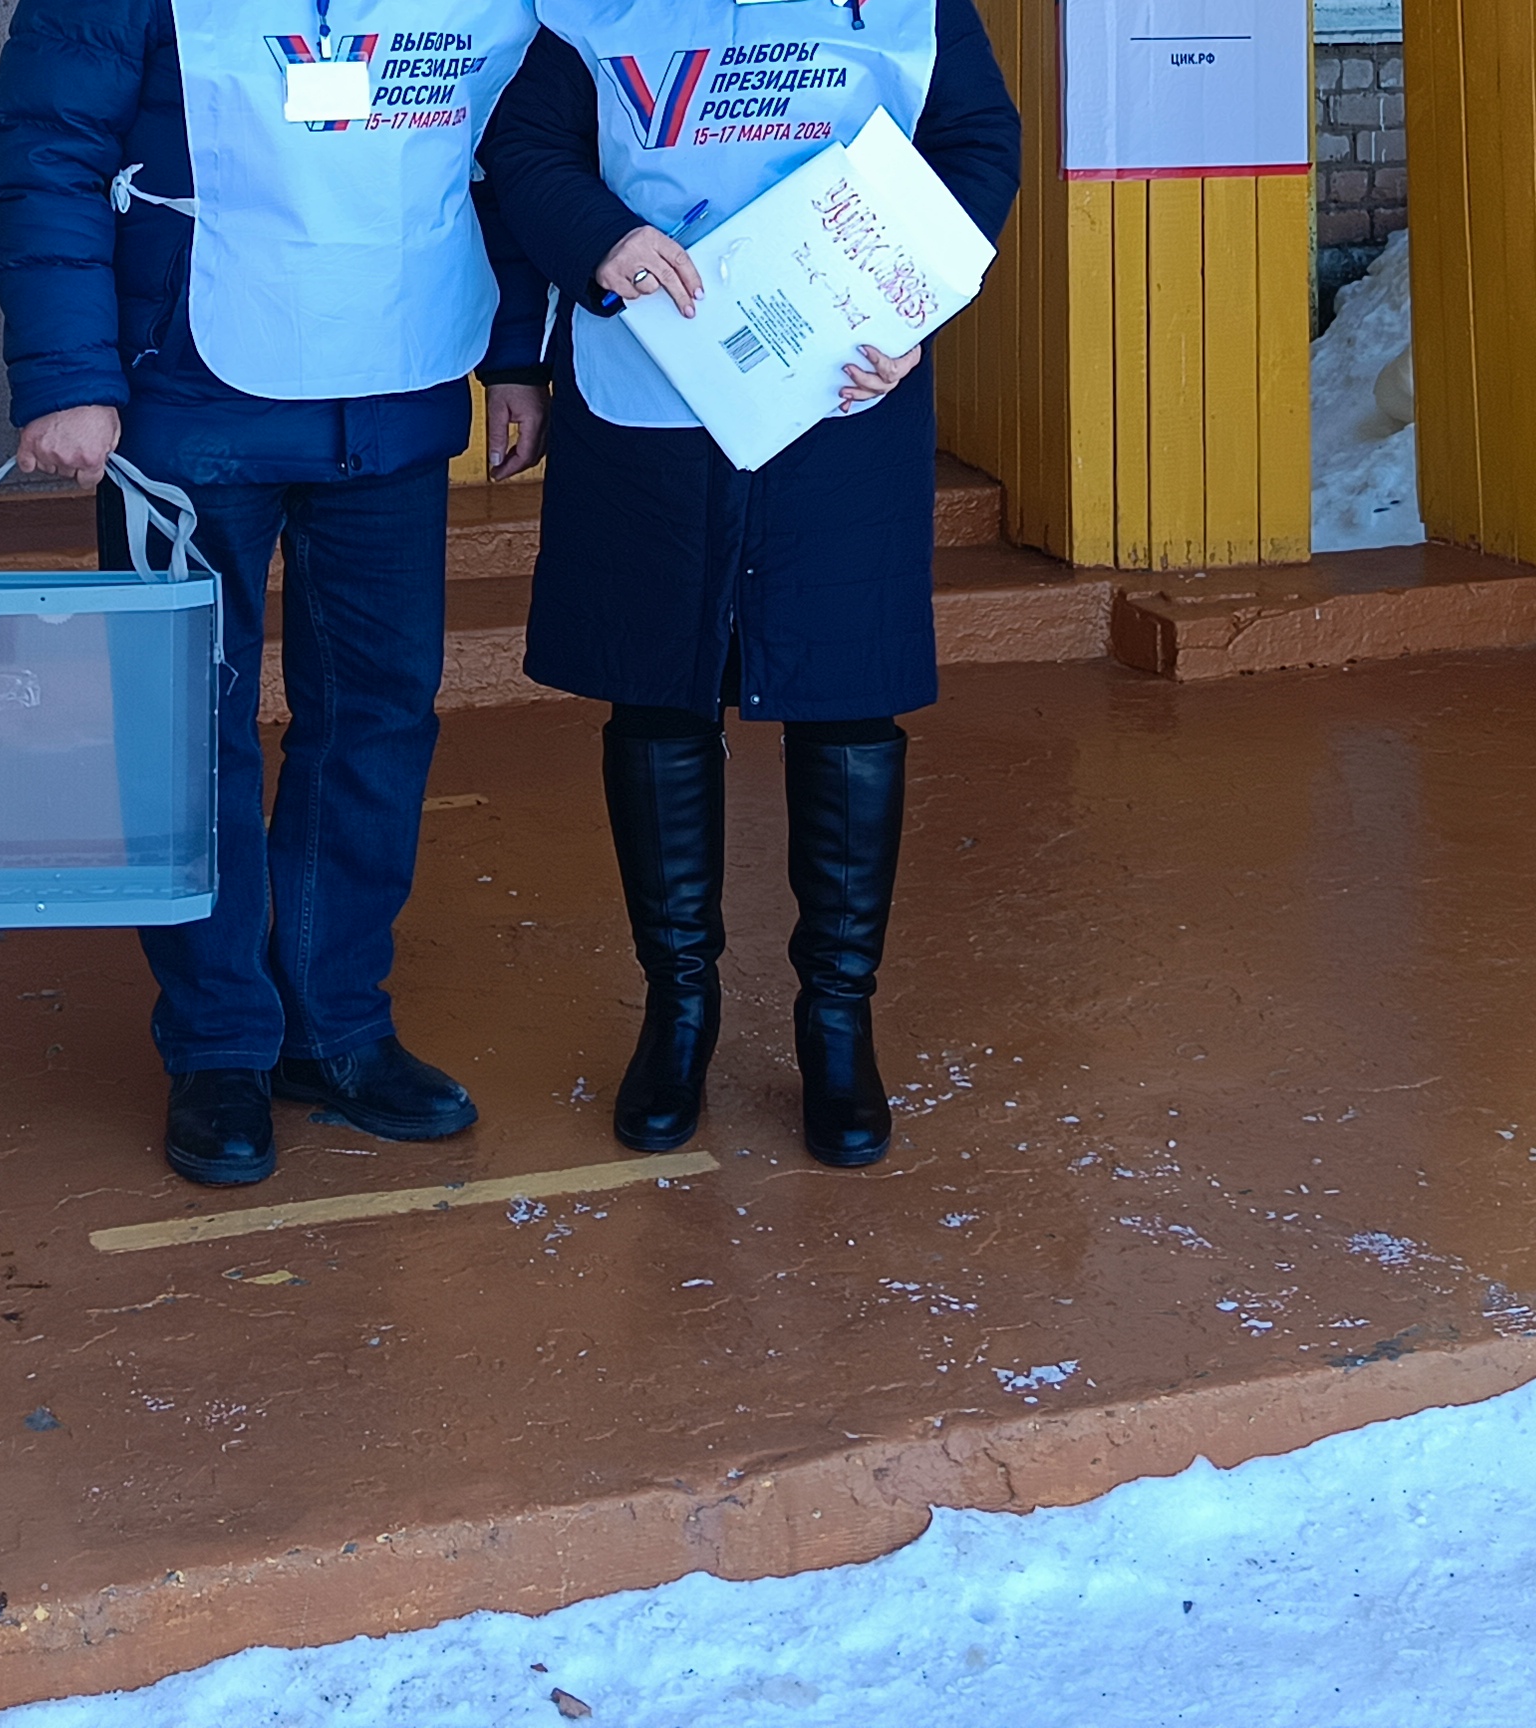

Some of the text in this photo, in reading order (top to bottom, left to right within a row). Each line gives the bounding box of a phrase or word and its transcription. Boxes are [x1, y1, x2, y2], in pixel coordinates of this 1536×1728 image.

[390, 32, 472, 52] ВЫБОРЫ
[719, 42, 820, 66] ВЫБОРЫ
[1171, 53, 1215, 66] ЦИК.РФ
[710, 68, 847, 94] ПРЕЗИДЕНТА
[372, 84, 455, 106] РОССИИ
[408, 110, 452, 128] МАРТА
[699, 98, 790, 121] РОССИИ
[736, 122, 792, 143] МАРТА
[794, 122, 831, 140] 2024
